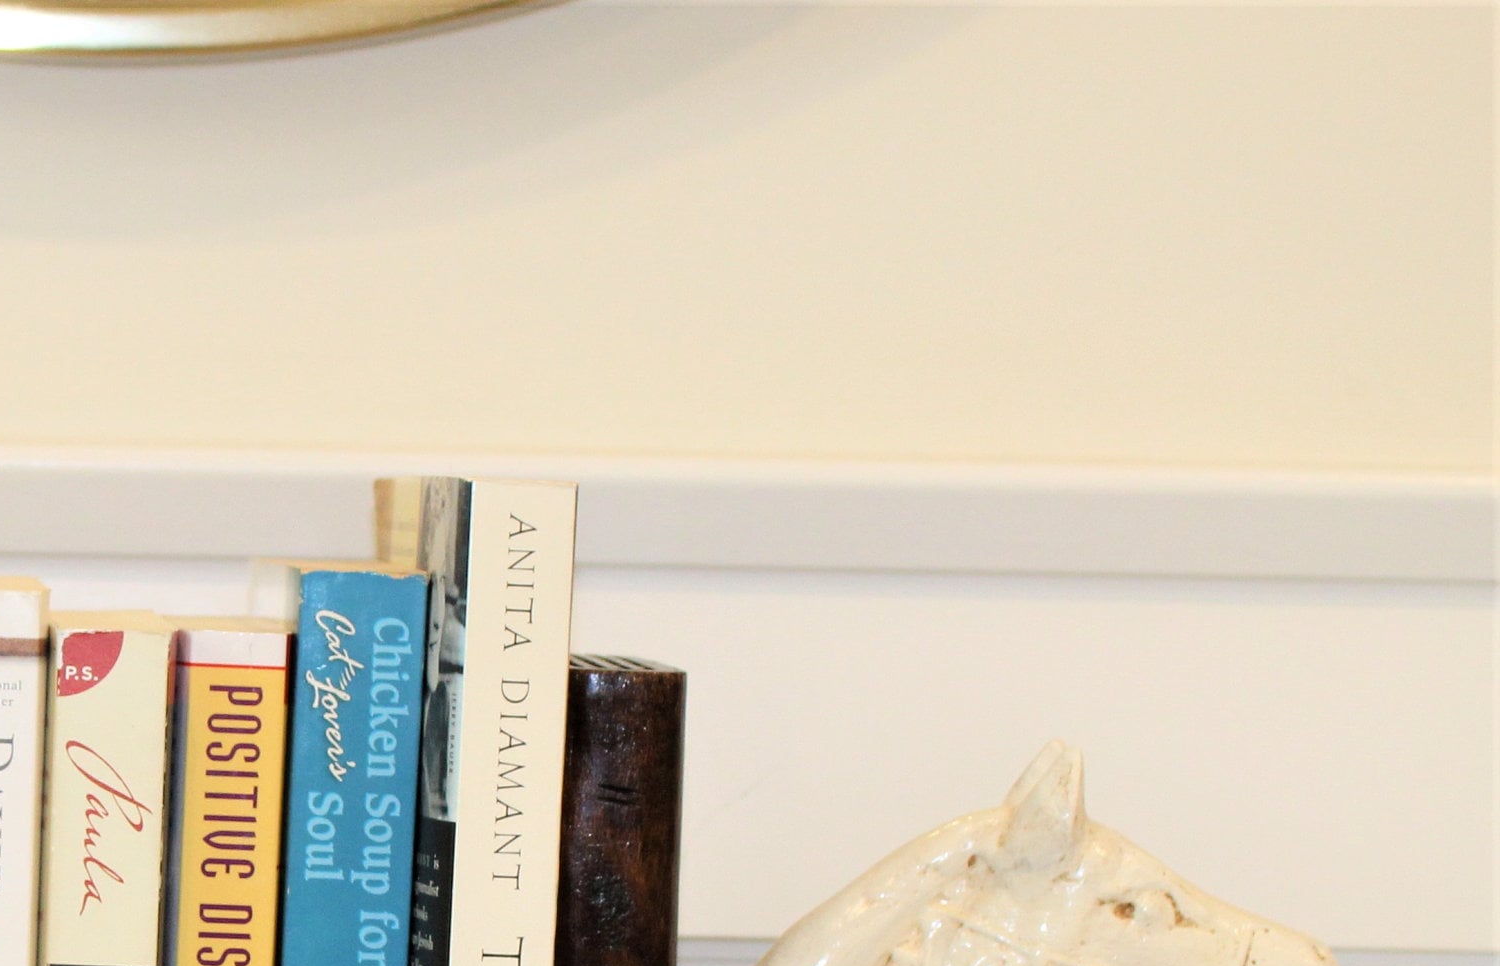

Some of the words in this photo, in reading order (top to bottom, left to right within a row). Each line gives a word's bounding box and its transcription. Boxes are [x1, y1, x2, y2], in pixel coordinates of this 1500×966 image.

[314, 608, 364, 674] Cat
[503, 511, 538, 652] ANITA
[64, 665, 99, 682] P.S.
[366, 616, 414, 780] Chicken
[65, 739, 153, 916] Paula
[200, 684, 264, 880] POSITIVE
[304, 790, 345, 883] Soul
[350, 791, 402, 897] Soup
[491, 676, 532, 890] DIAMANT
